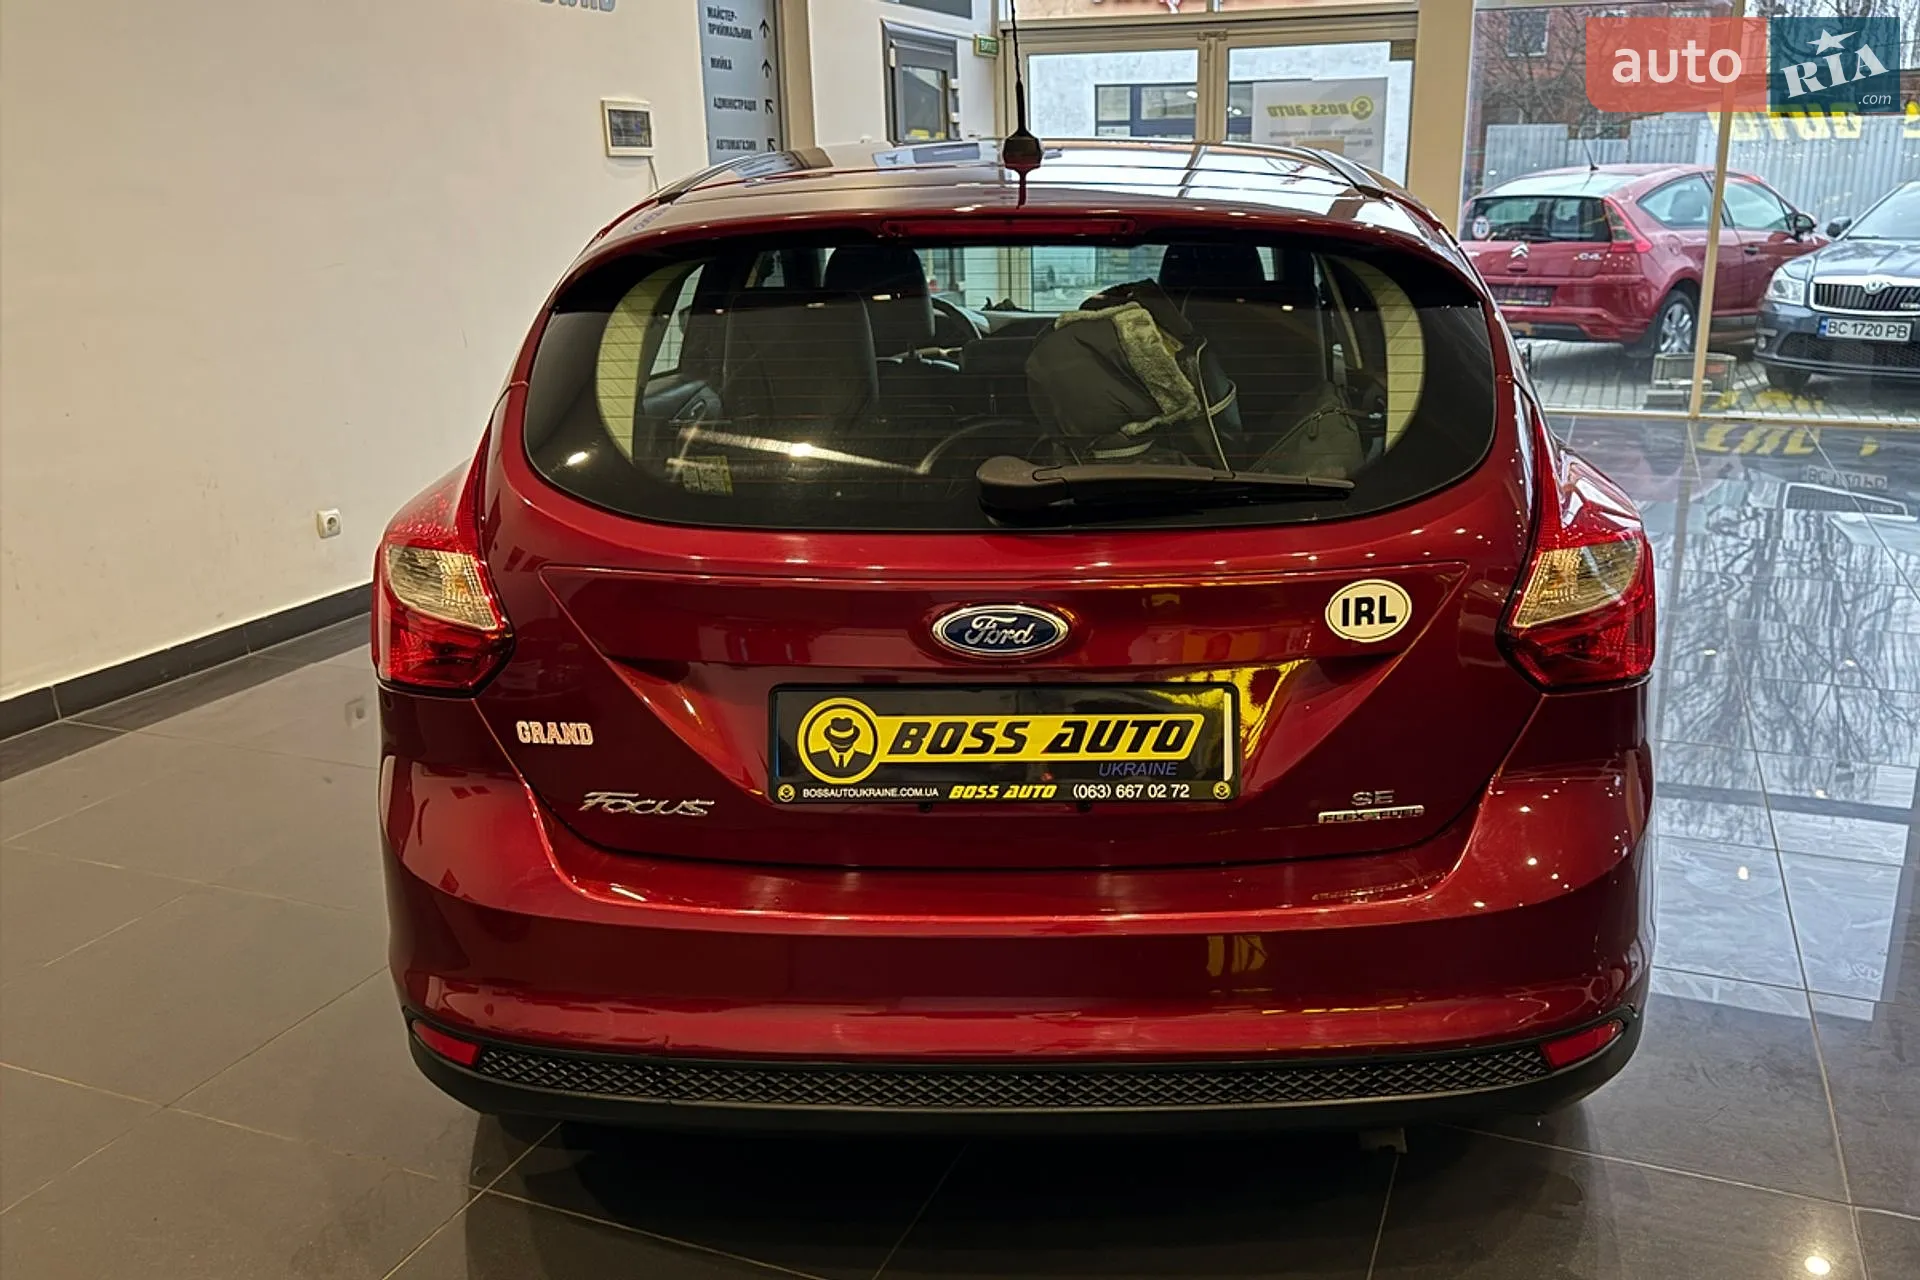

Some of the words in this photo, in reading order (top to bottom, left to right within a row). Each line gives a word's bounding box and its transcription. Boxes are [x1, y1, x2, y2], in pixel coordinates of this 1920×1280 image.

[1851, 323, 1883, 337] 1720
[1342, 595, 1397, 627] IRL
[964, 615, 1036, 645] Ford
[516, 720, 594, 745] GRAND
[887, 719, 1031, 755] BOSS
[1040, 719, 1195, 754] AUTO
[1099, 762, 1178, 777] UKRAINE
[802, 787, 939, 799] BOSSAUTOUKRAINE.COM.UA
[948, 785, 999, 799] BOSS
[1002, 785, 1057, 799] AUTO
[1073, 784, 1111, 799] (063)
[1116, 784, 1142, 798] 667
[1148, 784, 1167, 798] 02
[1171, 784, 1190, 798] 72
[1351, 789, 1394, 806] SE
